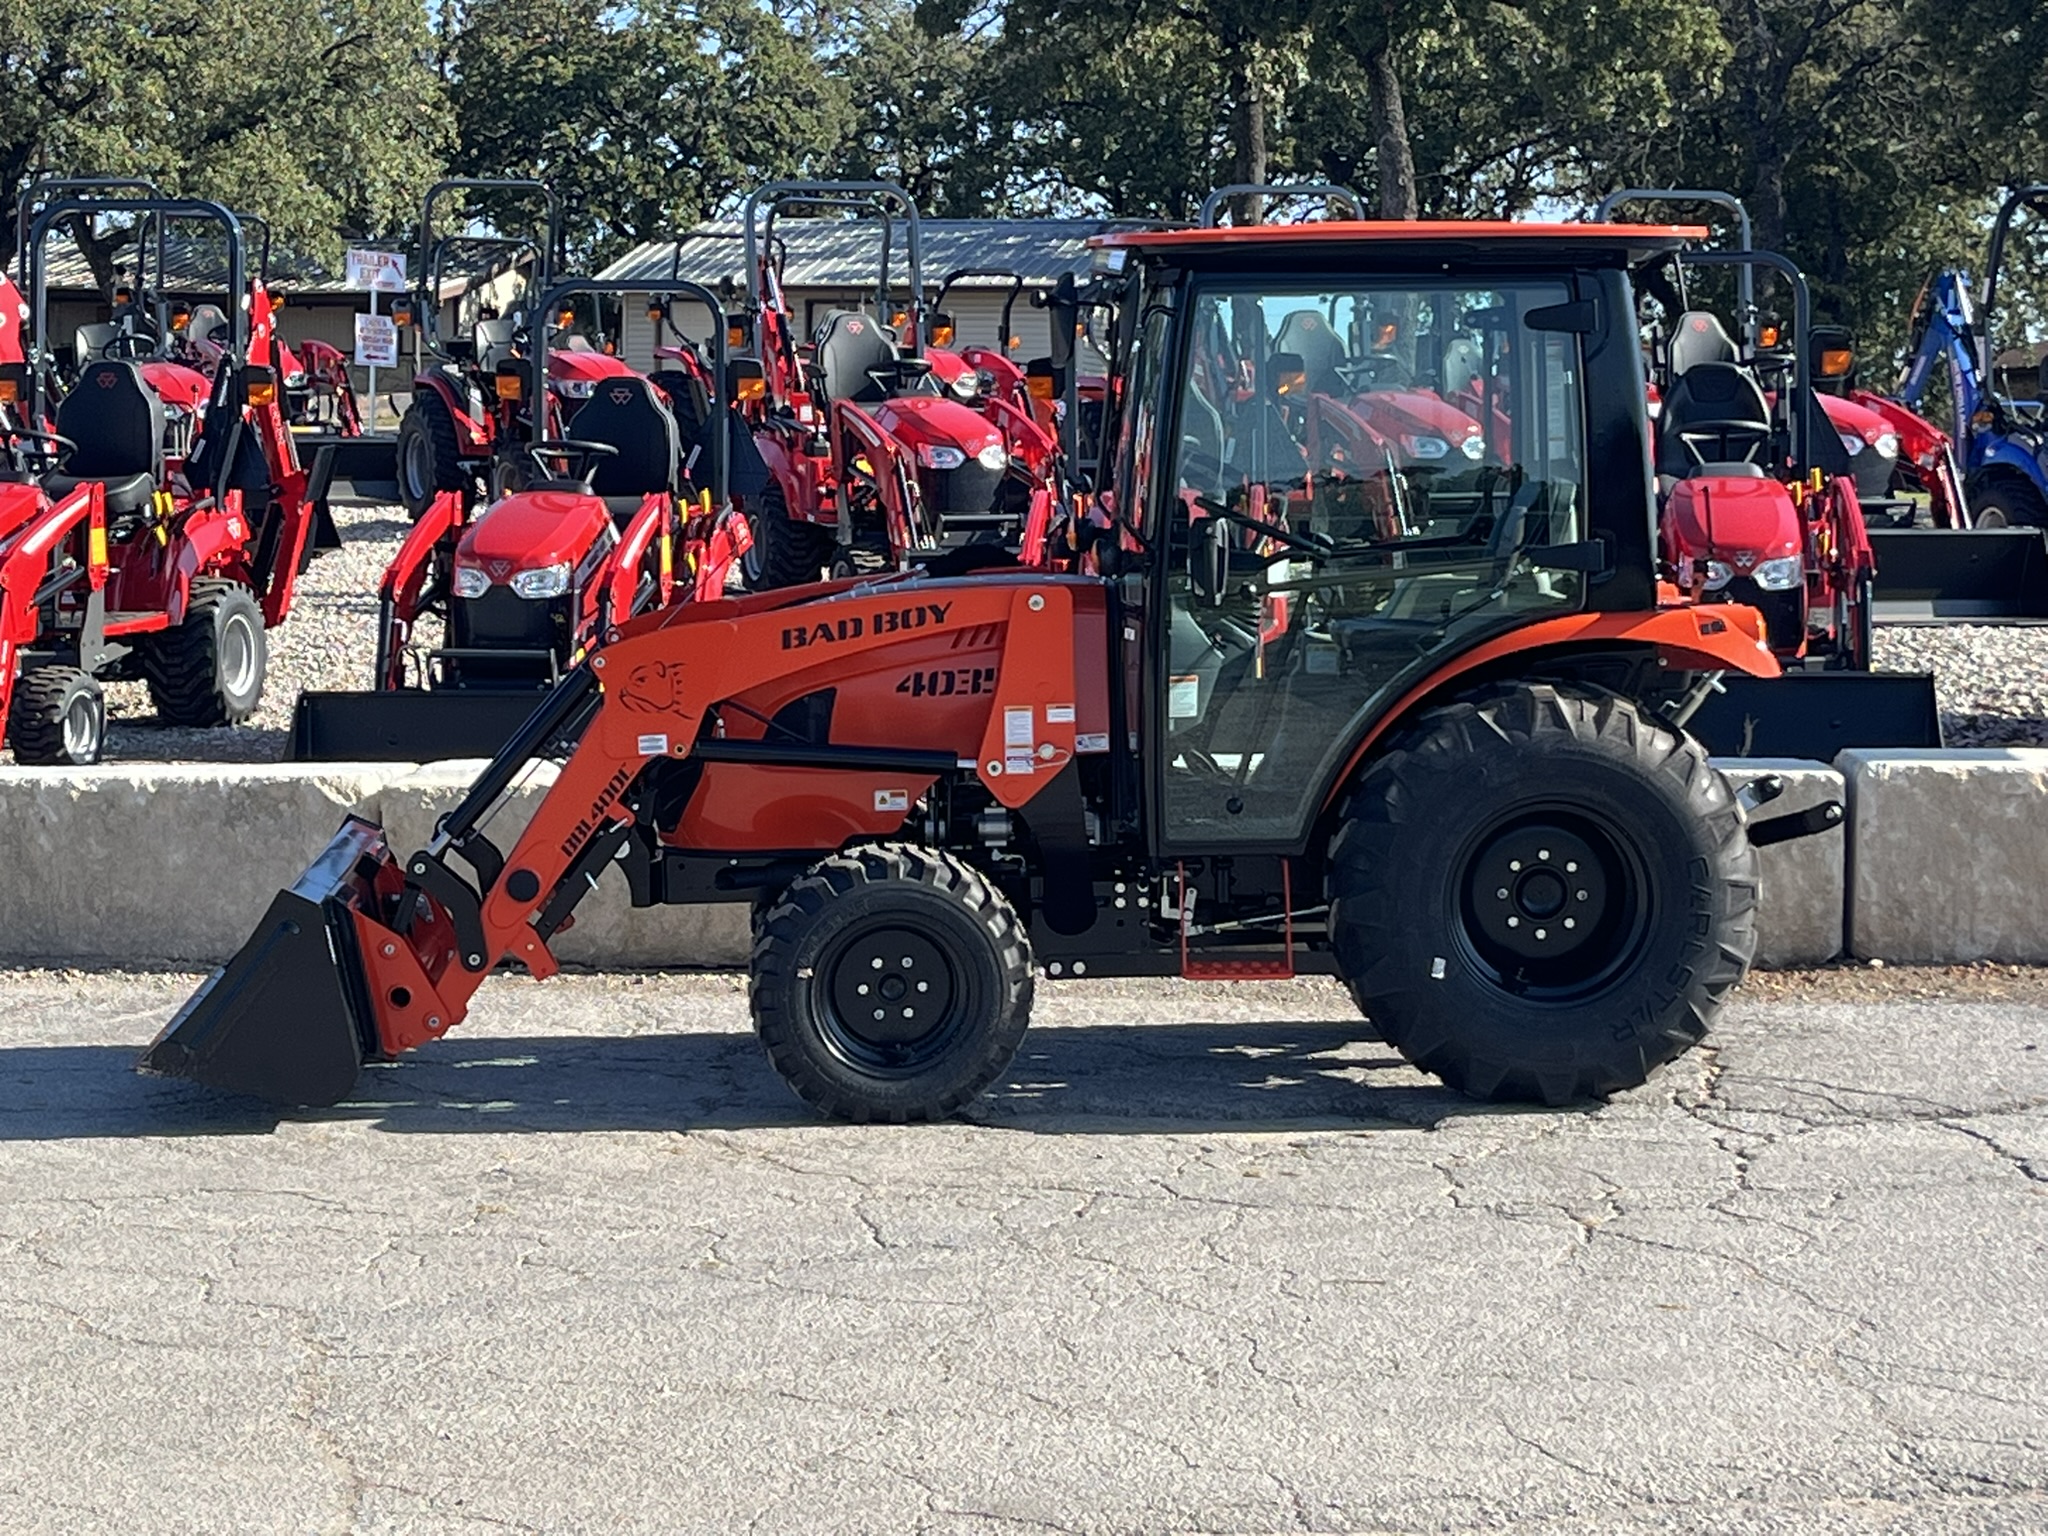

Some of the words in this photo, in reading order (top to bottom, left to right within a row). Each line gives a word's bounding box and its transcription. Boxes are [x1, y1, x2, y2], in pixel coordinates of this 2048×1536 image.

[351, 253, 389, 267] TRAILER
[781, 617, 863, 650] BAD
[873, 600, 954, 635] BOY
